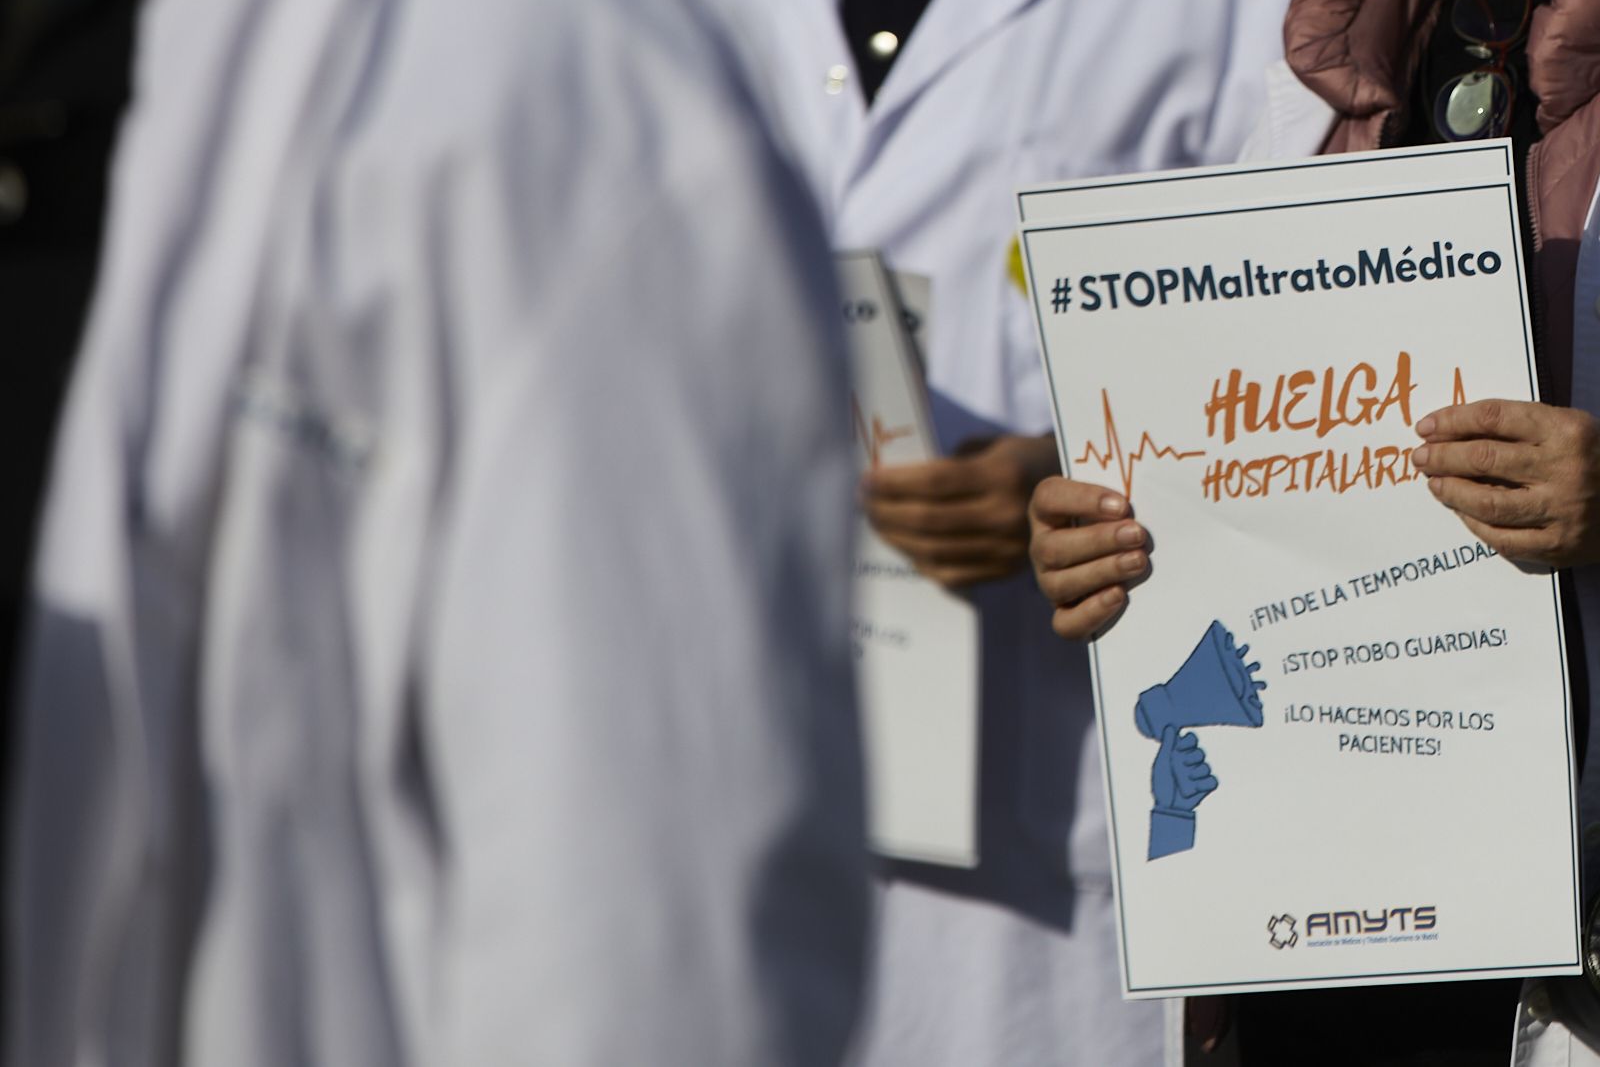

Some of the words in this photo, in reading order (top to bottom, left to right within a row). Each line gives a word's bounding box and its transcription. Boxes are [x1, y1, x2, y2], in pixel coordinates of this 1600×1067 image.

[1051, 241, 1501, 314] #STOPMaltratoMédico
[1205, 350, 1418, 445] HUELGA
[1202, 445, 1421, 503] HOSPITALARI
[1250, 598, 1288, 631] ¡FIN
[1291, 590, 1320, 616] DE
[1323, 584, 1348, 607] LA
[1282, 648, 1339, 675] ¡STOP
[1344, 640, 1400, 666] ROBO
[1405, 628, 1508, 658] GUARDIAS!
[1284, 704, 1315, 724] ¡LO
[1319, 706, 1410, 728] HACEMOS
[1416, 710, 1453, 730] POR
[1459, 712, 1495, 732] LOS
[1339, 733, 1442, 756] PACIENTES!
